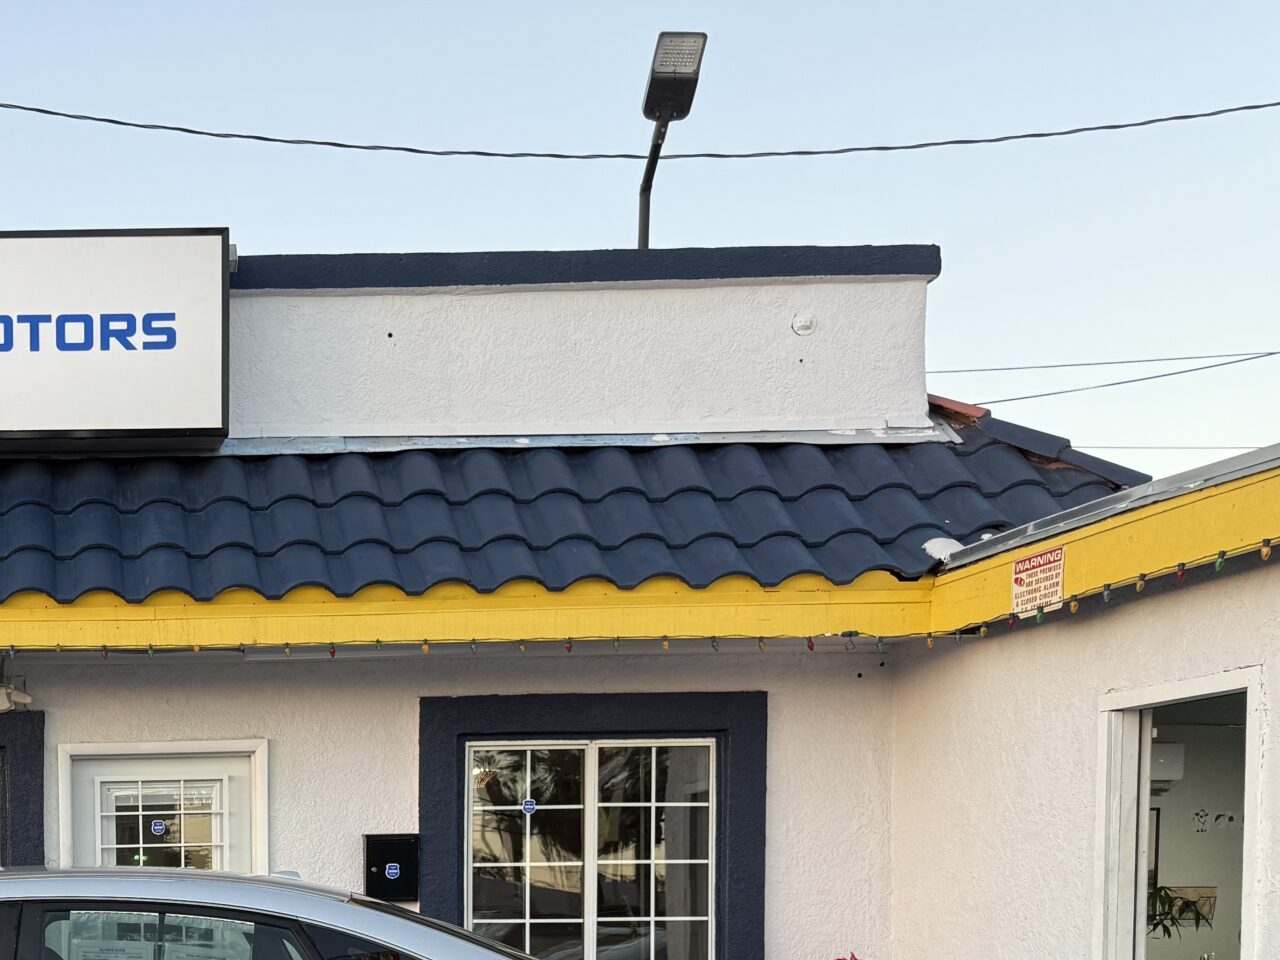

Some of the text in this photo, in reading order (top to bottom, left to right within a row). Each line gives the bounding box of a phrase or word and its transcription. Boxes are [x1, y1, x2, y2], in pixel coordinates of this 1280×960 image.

[1016, 550, 1062, 572] WARNING
[1015, 580, 1059, 599] ELECTRONIC ALARM
